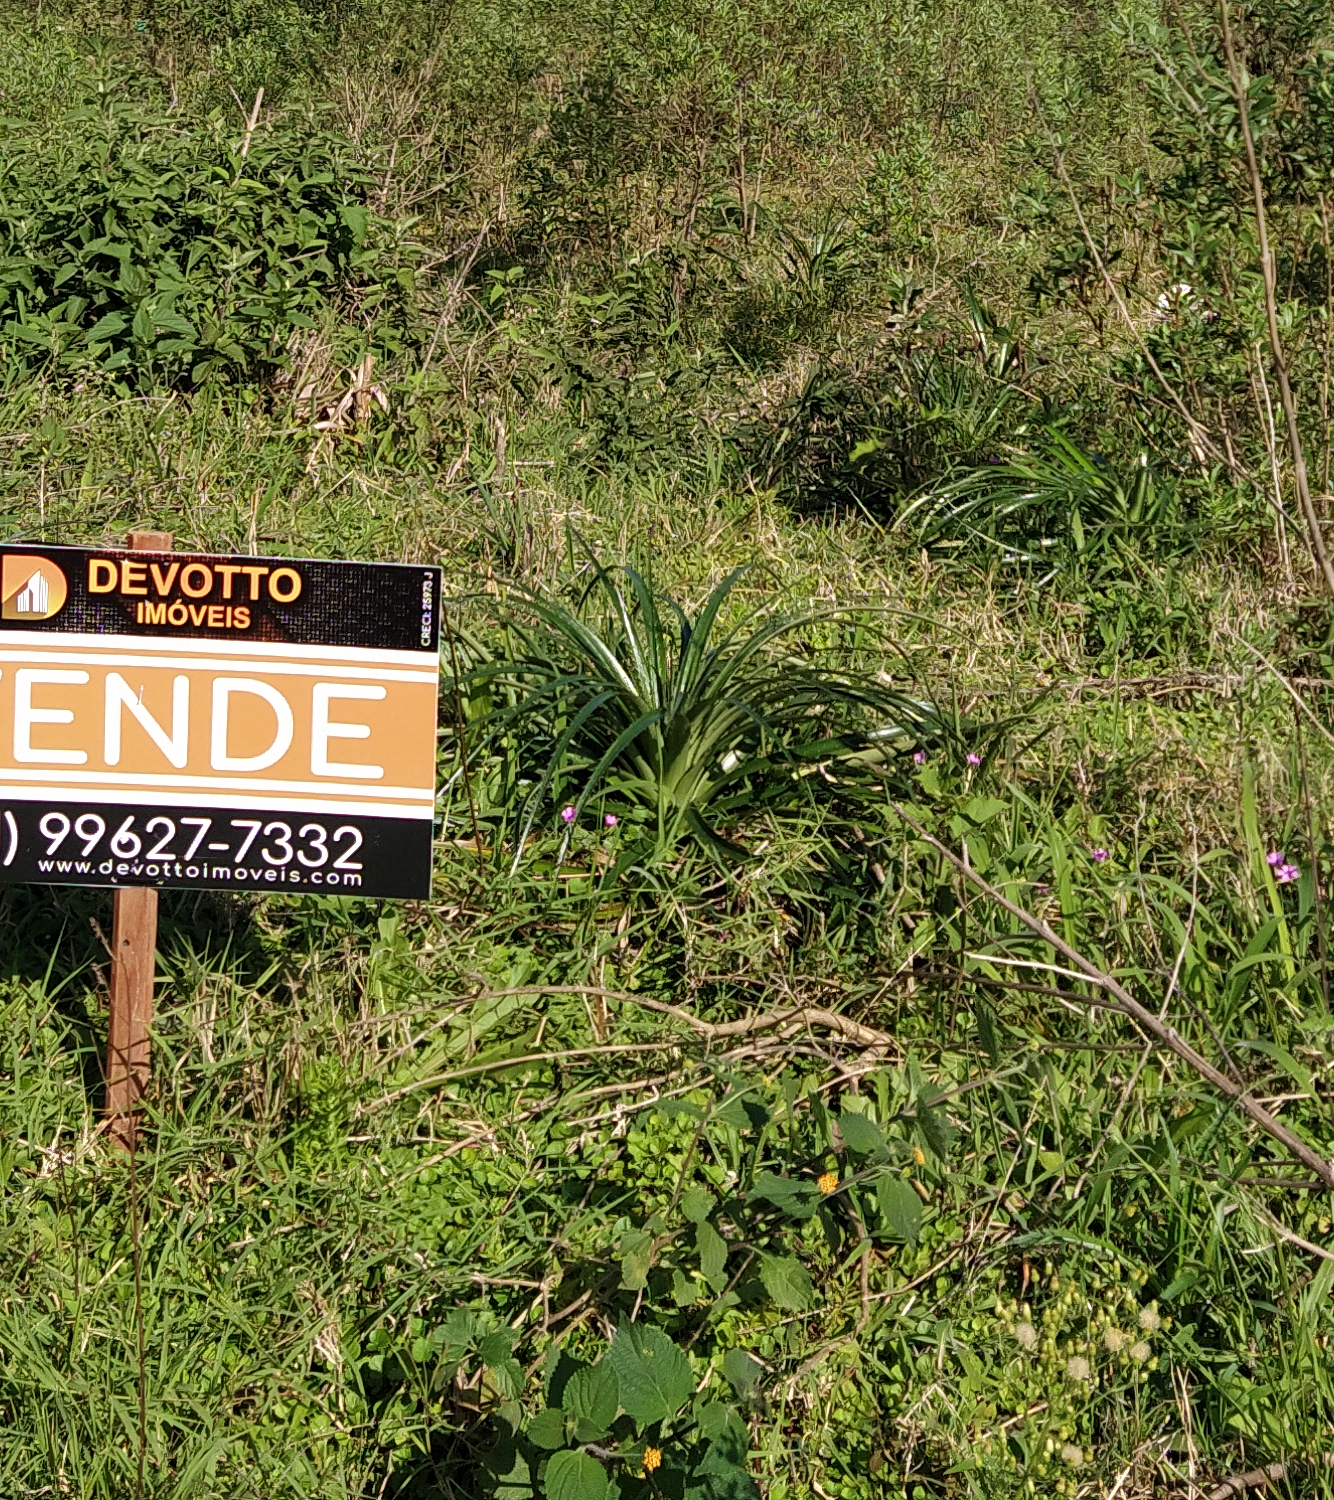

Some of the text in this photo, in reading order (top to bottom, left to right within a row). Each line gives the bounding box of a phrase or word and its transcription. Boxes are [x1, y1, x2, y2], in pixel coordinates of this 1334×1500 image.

[88, 558, 302, 603] DEVOTTO
[136, 598, 252, 629] IMÓVEIS
[38, 811, 364, 871] 99627-7332
[37, 856, 363, 888] www.devottoimoveis.com
